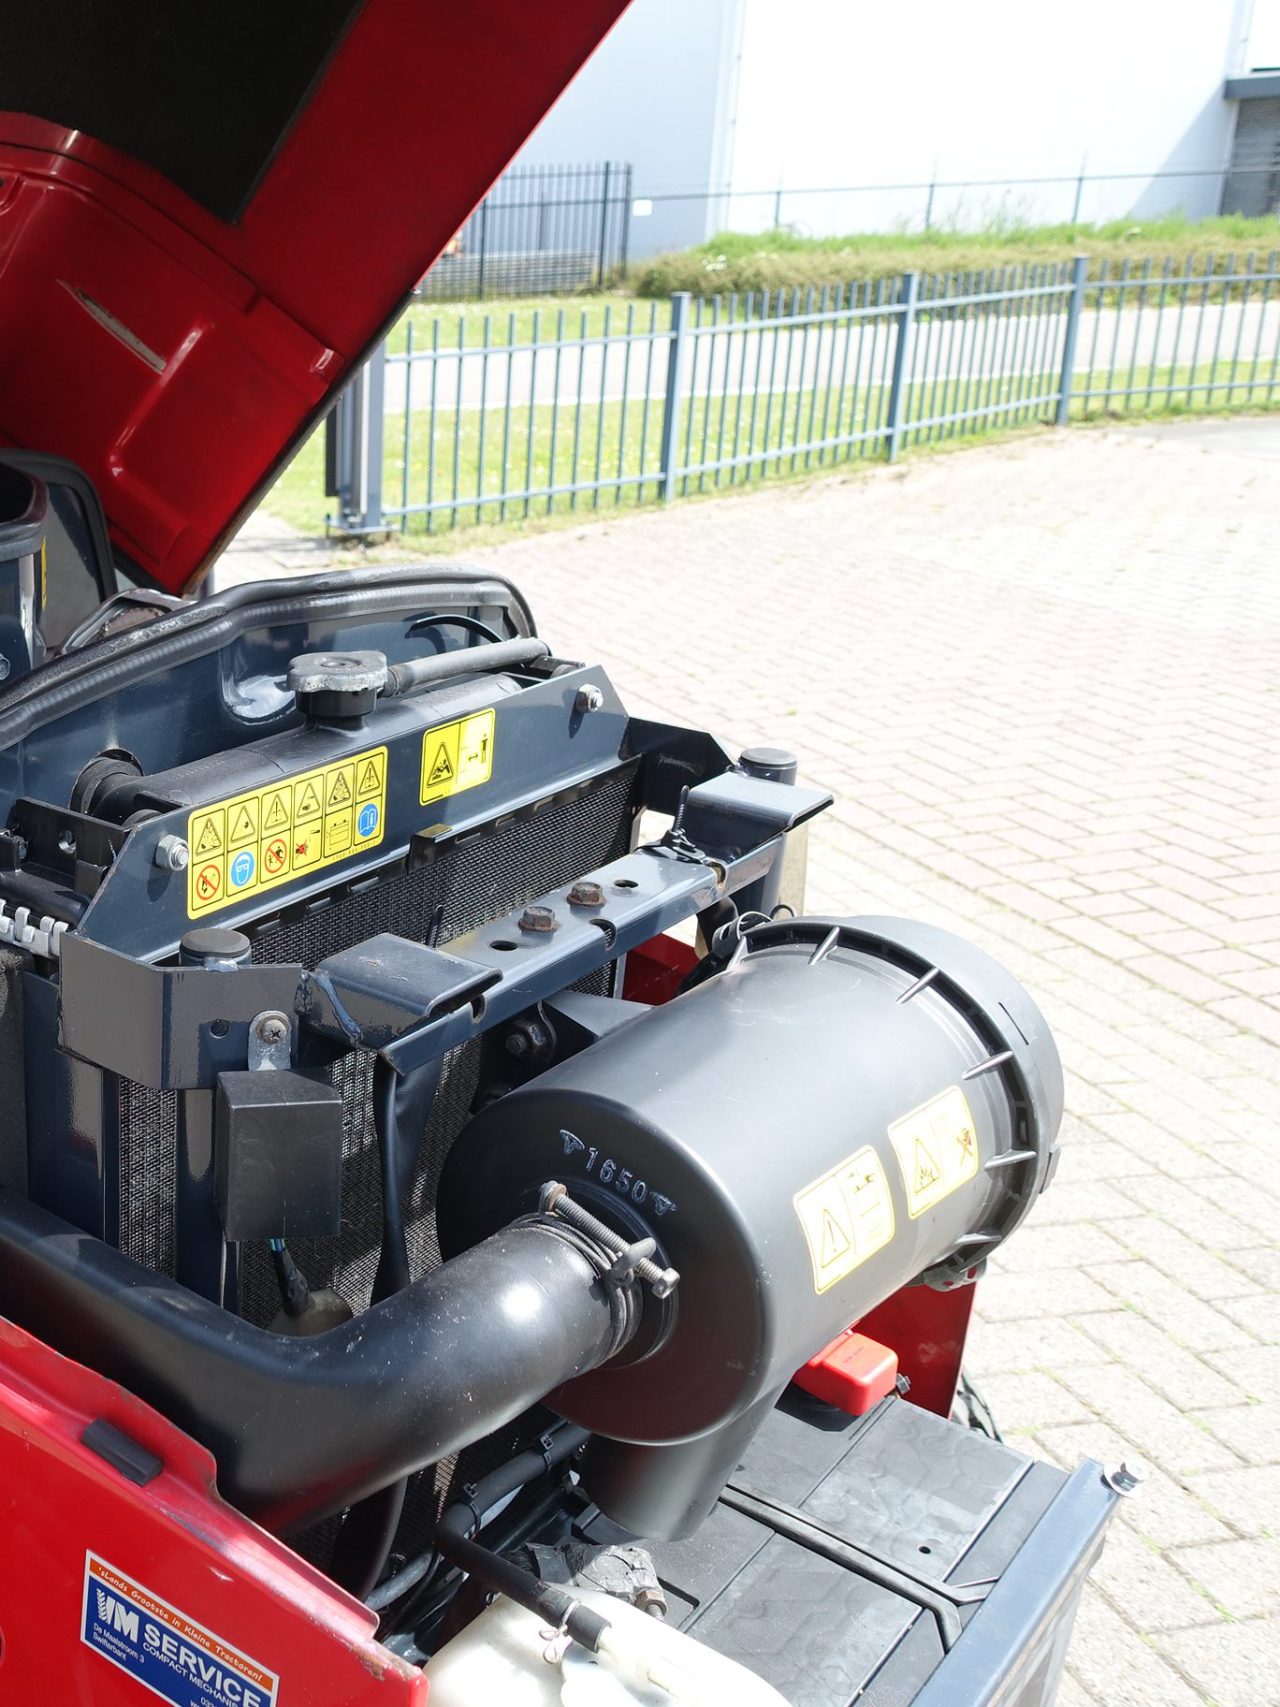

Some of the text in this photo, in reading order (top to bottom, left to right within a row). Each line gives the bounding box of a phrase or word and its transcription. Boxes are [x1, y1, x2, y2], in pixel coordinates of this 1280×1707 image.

[585, 1147, 648, 1204] 1650
[131, 1590, 169, 1620] Grootste
[184, 1625, 211, 1648] Kleine
[142, 1642, 188, 1677] COMPACT
[144, 1623, 261, 1707] SERVICE
